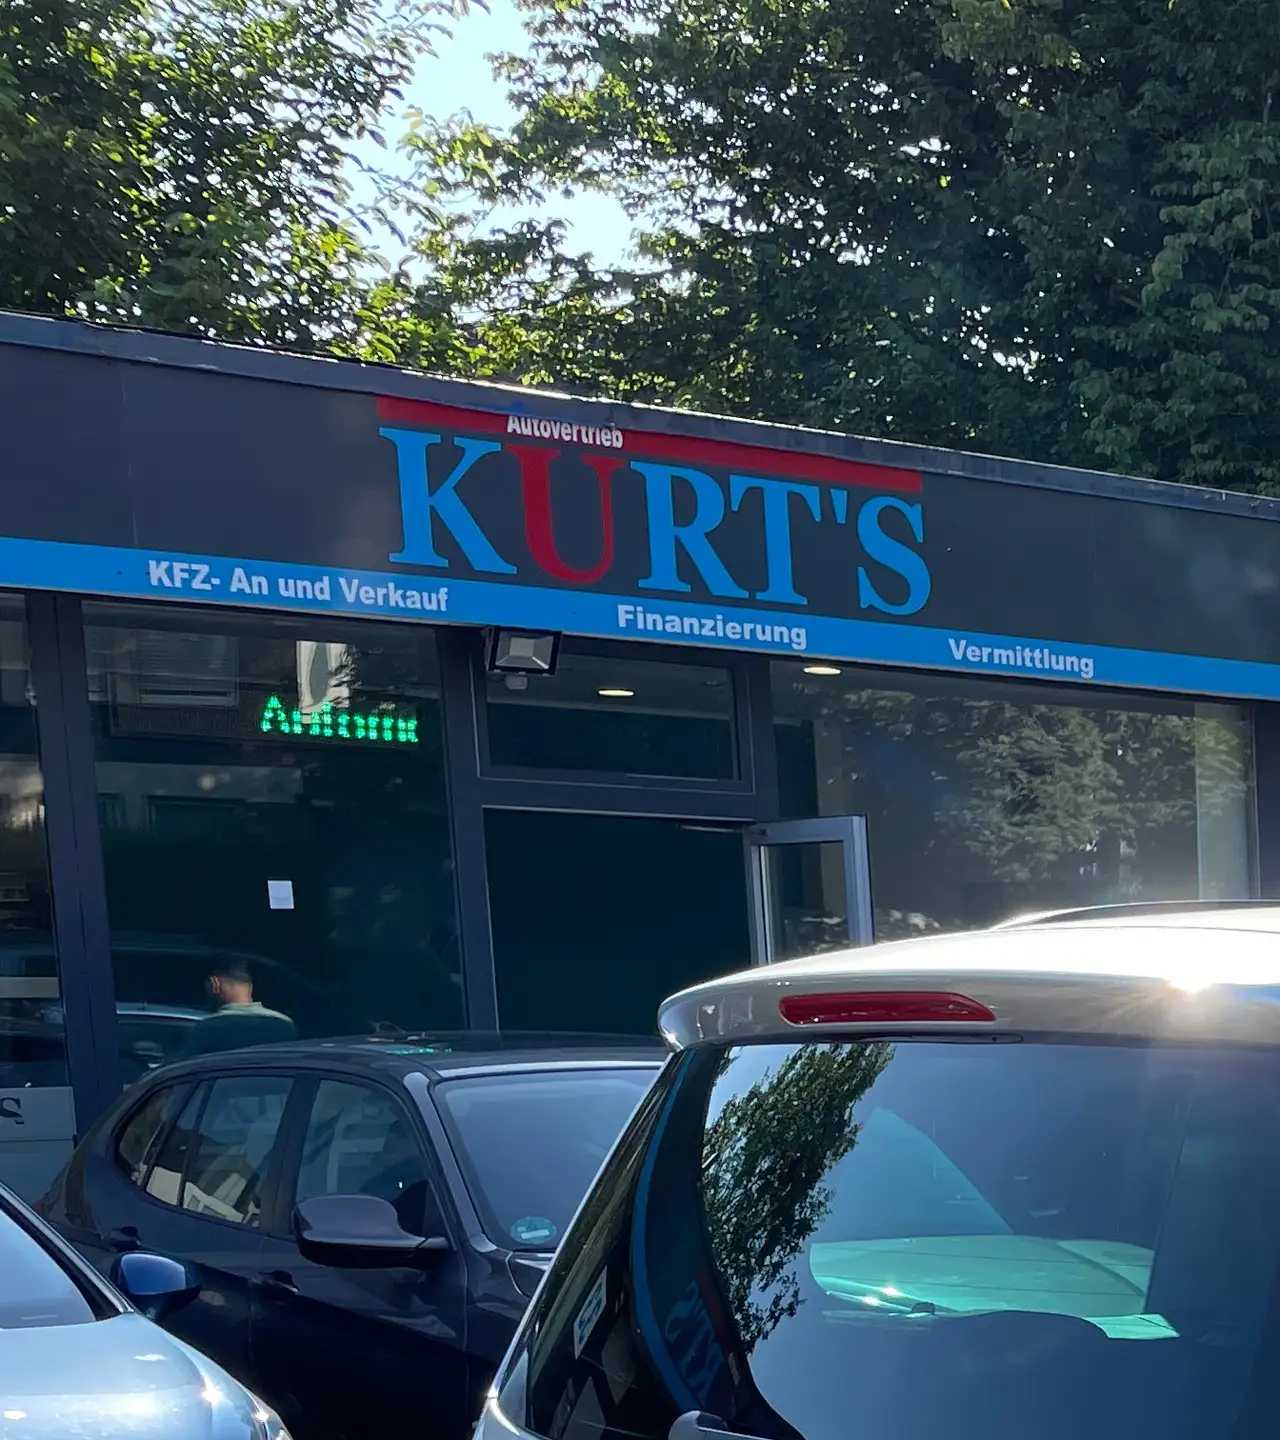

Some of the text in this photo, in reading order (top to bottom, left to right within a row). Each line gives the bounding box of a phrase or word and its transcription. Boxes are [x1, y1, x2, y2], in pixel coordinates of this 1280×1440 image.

[506, 415, 623, 449] Autovertrieb
[378, 426, 932, 617] KURT'S
[148, 559, 449, 613] KFZ- An und Verkauf
[616, 604, 807, 650] Finanzierung
[947, 638, 1094, 679] Vermittlung
